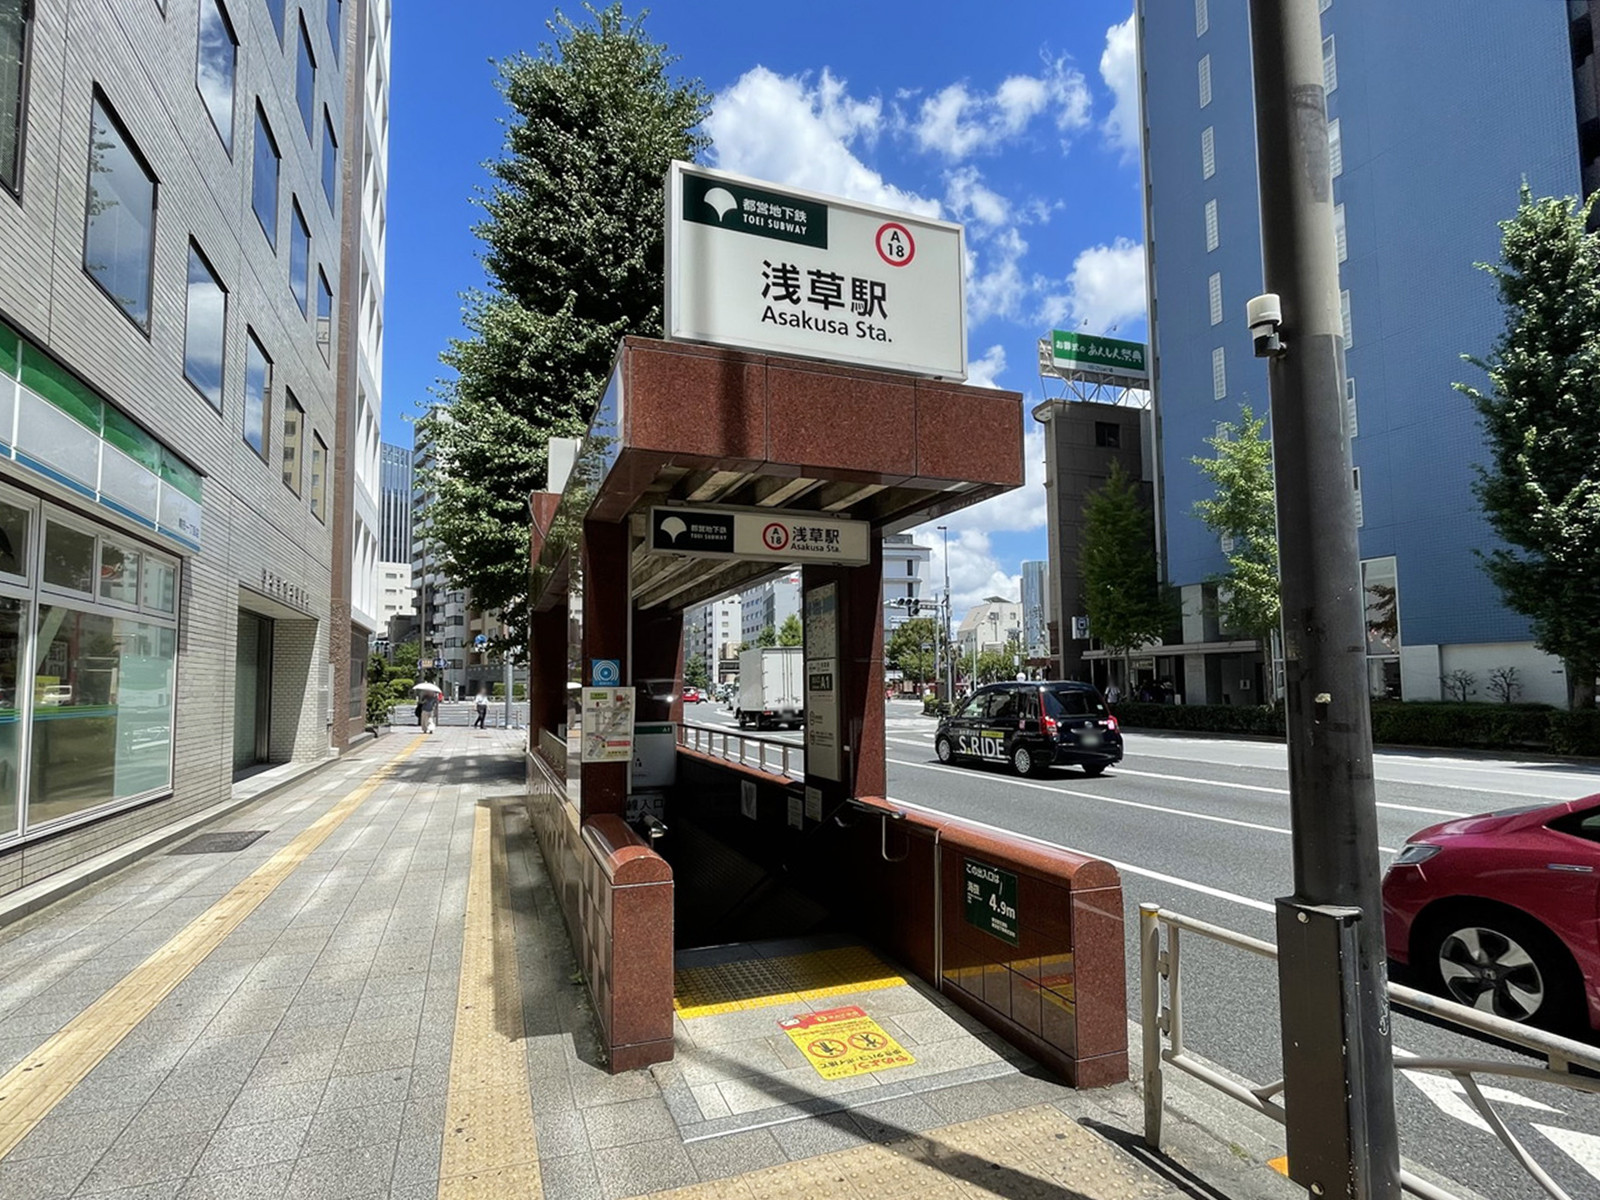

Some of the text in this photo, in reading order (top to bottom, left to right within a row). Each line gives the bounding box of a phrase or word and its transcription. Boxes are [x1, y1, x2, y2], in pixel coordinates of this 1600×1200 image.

[742, 198, 808, 223] 都営地下鉄
[743, 213, 808, 235] TOEI SUBWAY
[890, 230, 900, 243] A
[887, 243, 905, 258] 18
[761, 259, 888, 320] 浅草駅
[761, 305, 893, 343] Asakusa Sta.
[1088, 343, 1142, 363] あんしん祭典
[770, 535, 782, 545] 18
[772, 527, 780, 535] A
[792, 526, 840, 544] 浅草駅
[790, 543, 825, 552] Asakusa
[958, 735, 1006, 759] S.RIDE
[989, 893, 1016, 920] 4.9m
